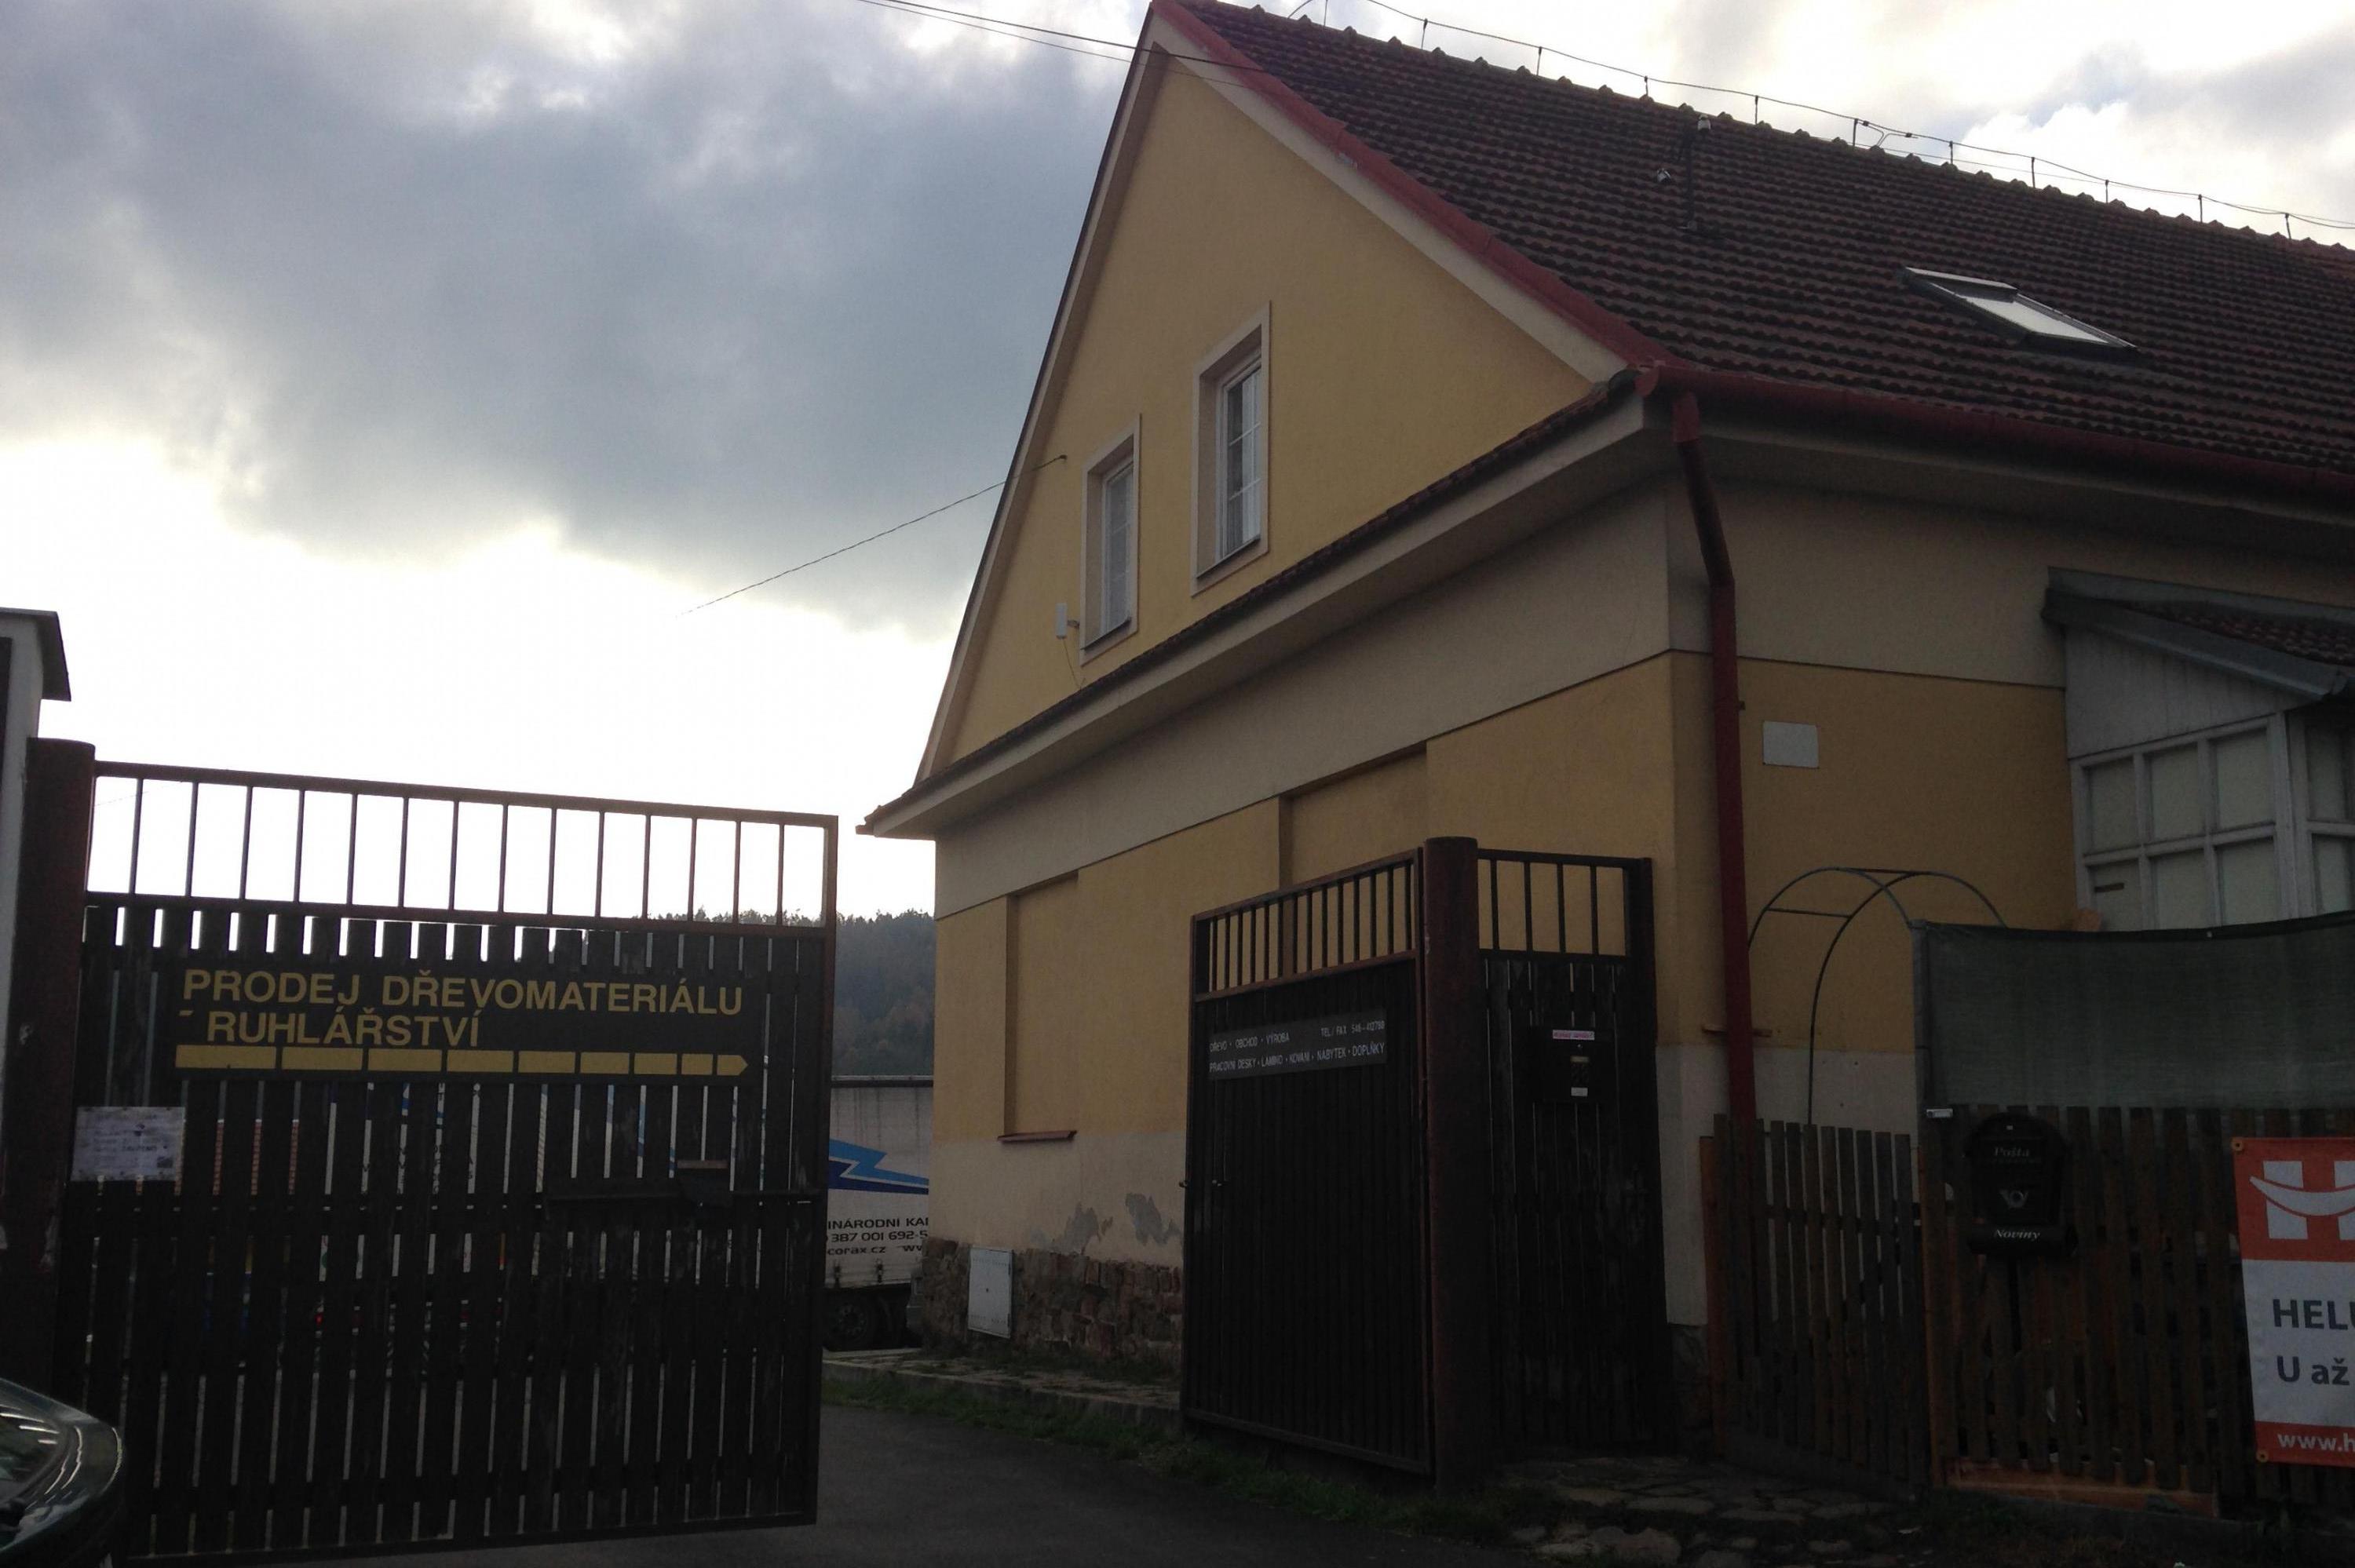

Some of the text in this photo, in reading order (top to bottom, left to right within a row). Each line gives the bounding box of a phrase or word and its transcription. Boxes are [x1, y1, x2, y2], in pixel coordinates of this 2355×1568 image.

[183, 968, 743, 1016] PRODEJ DŘEVOMATERIÁLU
[179, 1005, 483, 1047] RUHLÁŘSTVÍ
[831, 1232, 858, 1243] 387
[1993, 1229, 2041, 1242] Noviny
[2273, 1298, 2355, 1329] HEL
[2276, 1355, 2350, 1386] U až
